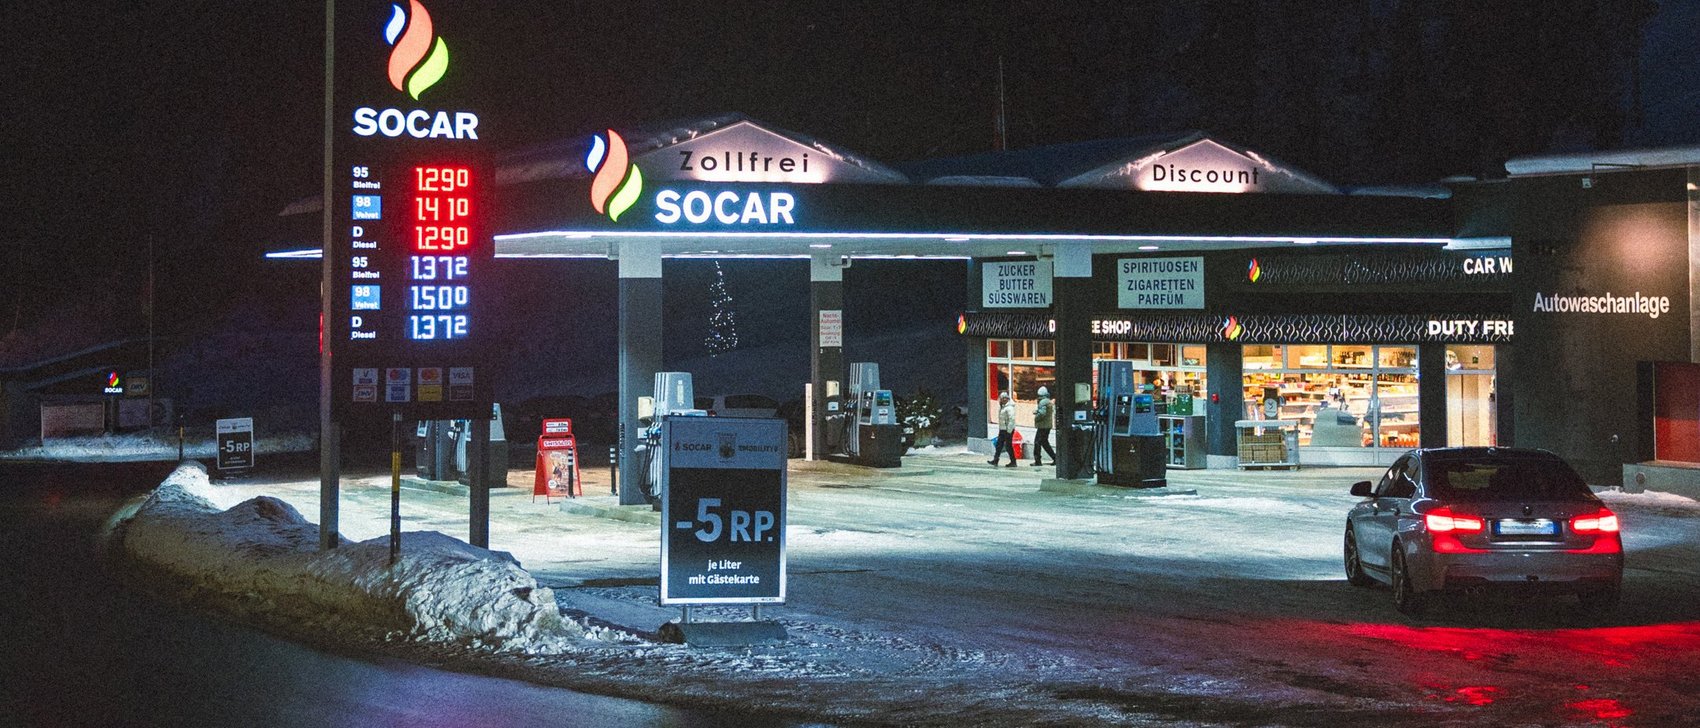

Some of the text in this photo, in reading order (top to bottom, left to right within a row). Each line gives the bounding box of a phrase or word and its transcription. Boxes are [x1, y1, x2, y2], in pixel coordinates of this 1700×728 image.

[353, 107, 479, 139] SOCAR
[680, 151, 808, 172] Zollfrei
[353, 167, 369, 178] 95
[1153, 164, 1259, 184] Discount
[353, 181, 381, 189] Bleifrei
[356, 196, 371, 207] 98
[655, 190, 795, 224] SOCAR
[353, 226, 363, 237] D
[353, 241, 377, 249] Diesel
[352, 257, 368, 268] 95
[1123, 261, 1198, 274] SPIRITUOSEN
[1463, 258, 1495, 274] CAR
[353, 271, 380, 279] Bleifrei
[998, 265, 1035, 277] ZUCKER
[1000, 279, 1034, 291] BUTTER
[1127, 279, 1195, 291] ZIGARETTEN
[355, 286, 370, 297] 98
[988, 290, 1046, 305] SÜSSWAREN
[1138, 290, 1184, 305] PARFÜM
[1533, 292, 1670, 318] Autowaschanlage
[352, 317, 362, 327] D
[1102, 320, 1132, 334] SHOP
[1428, 320, 1478, 335] DUTY
[352, 331, 376, 339] Diesel
[453, 372, 471, 380] VISA
[220, 441, 235, 453] -5
[683, 443, 712, 451] SOCAR
[676, 498, 775, 542] -5 RP.
[708, 560, 742, 570] je Liter
[689, 574, 760, 585] mit Gästekarte
